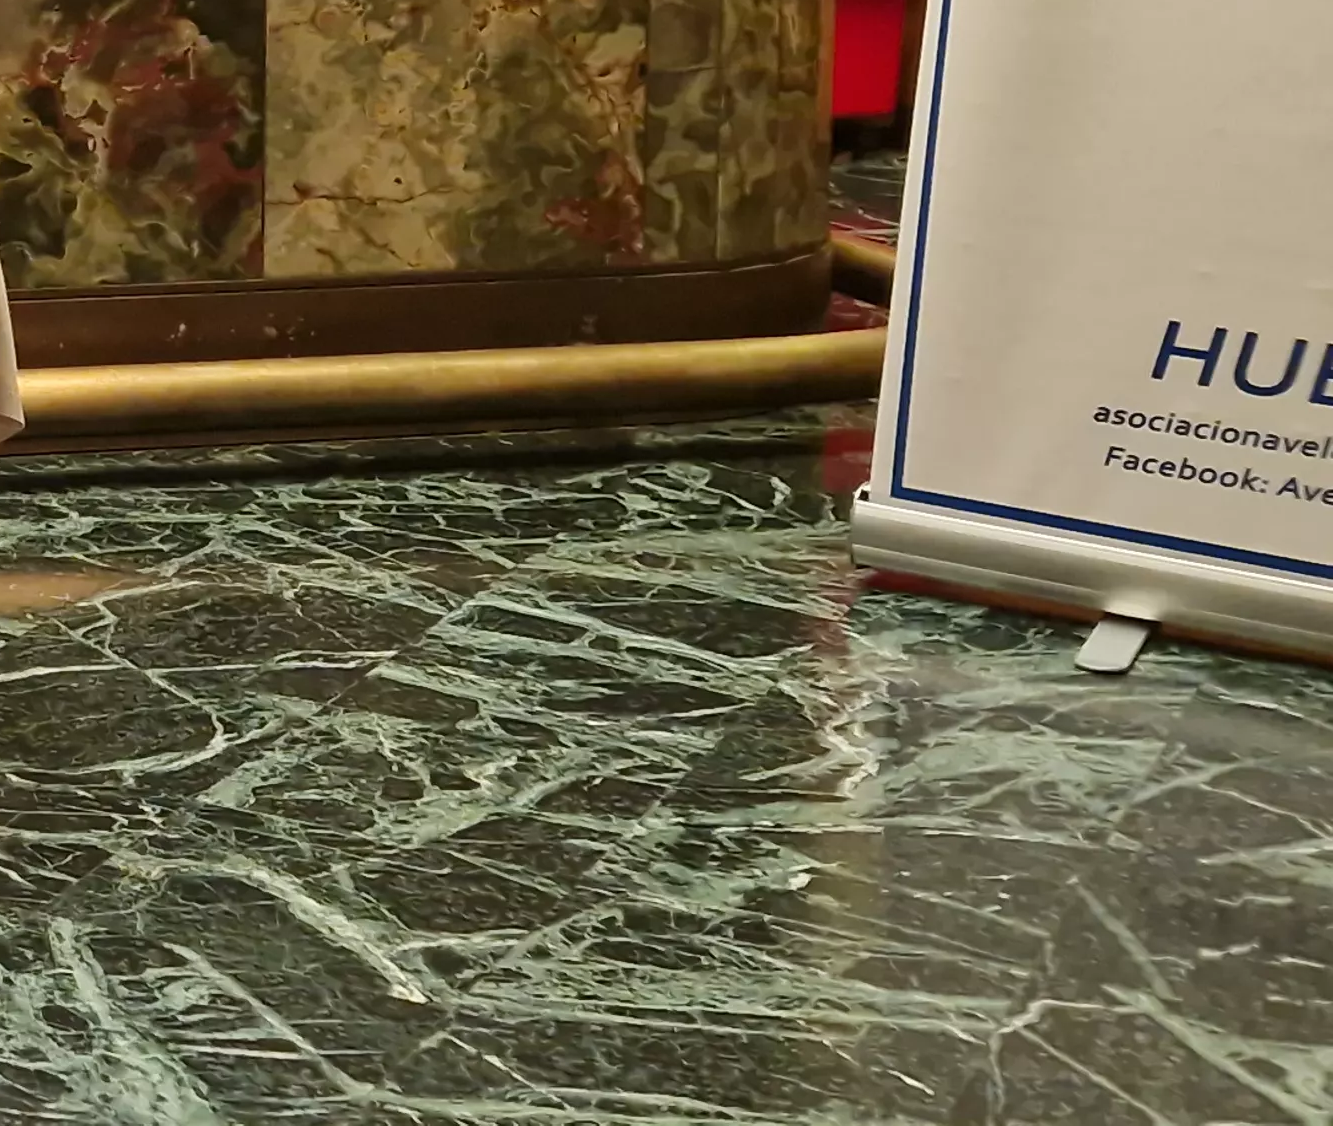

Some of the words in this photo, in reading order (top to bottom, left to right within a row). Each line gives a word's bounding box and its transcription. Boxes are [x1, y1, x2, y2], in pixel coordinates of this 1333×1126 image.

[1150, 320, 1333, 407] HUE
[1092, 404, 1333, 460] asociacionavel
[1103, 445, 1269, 494] Facebook:
[1276, 476, 1333, 506] Ave
